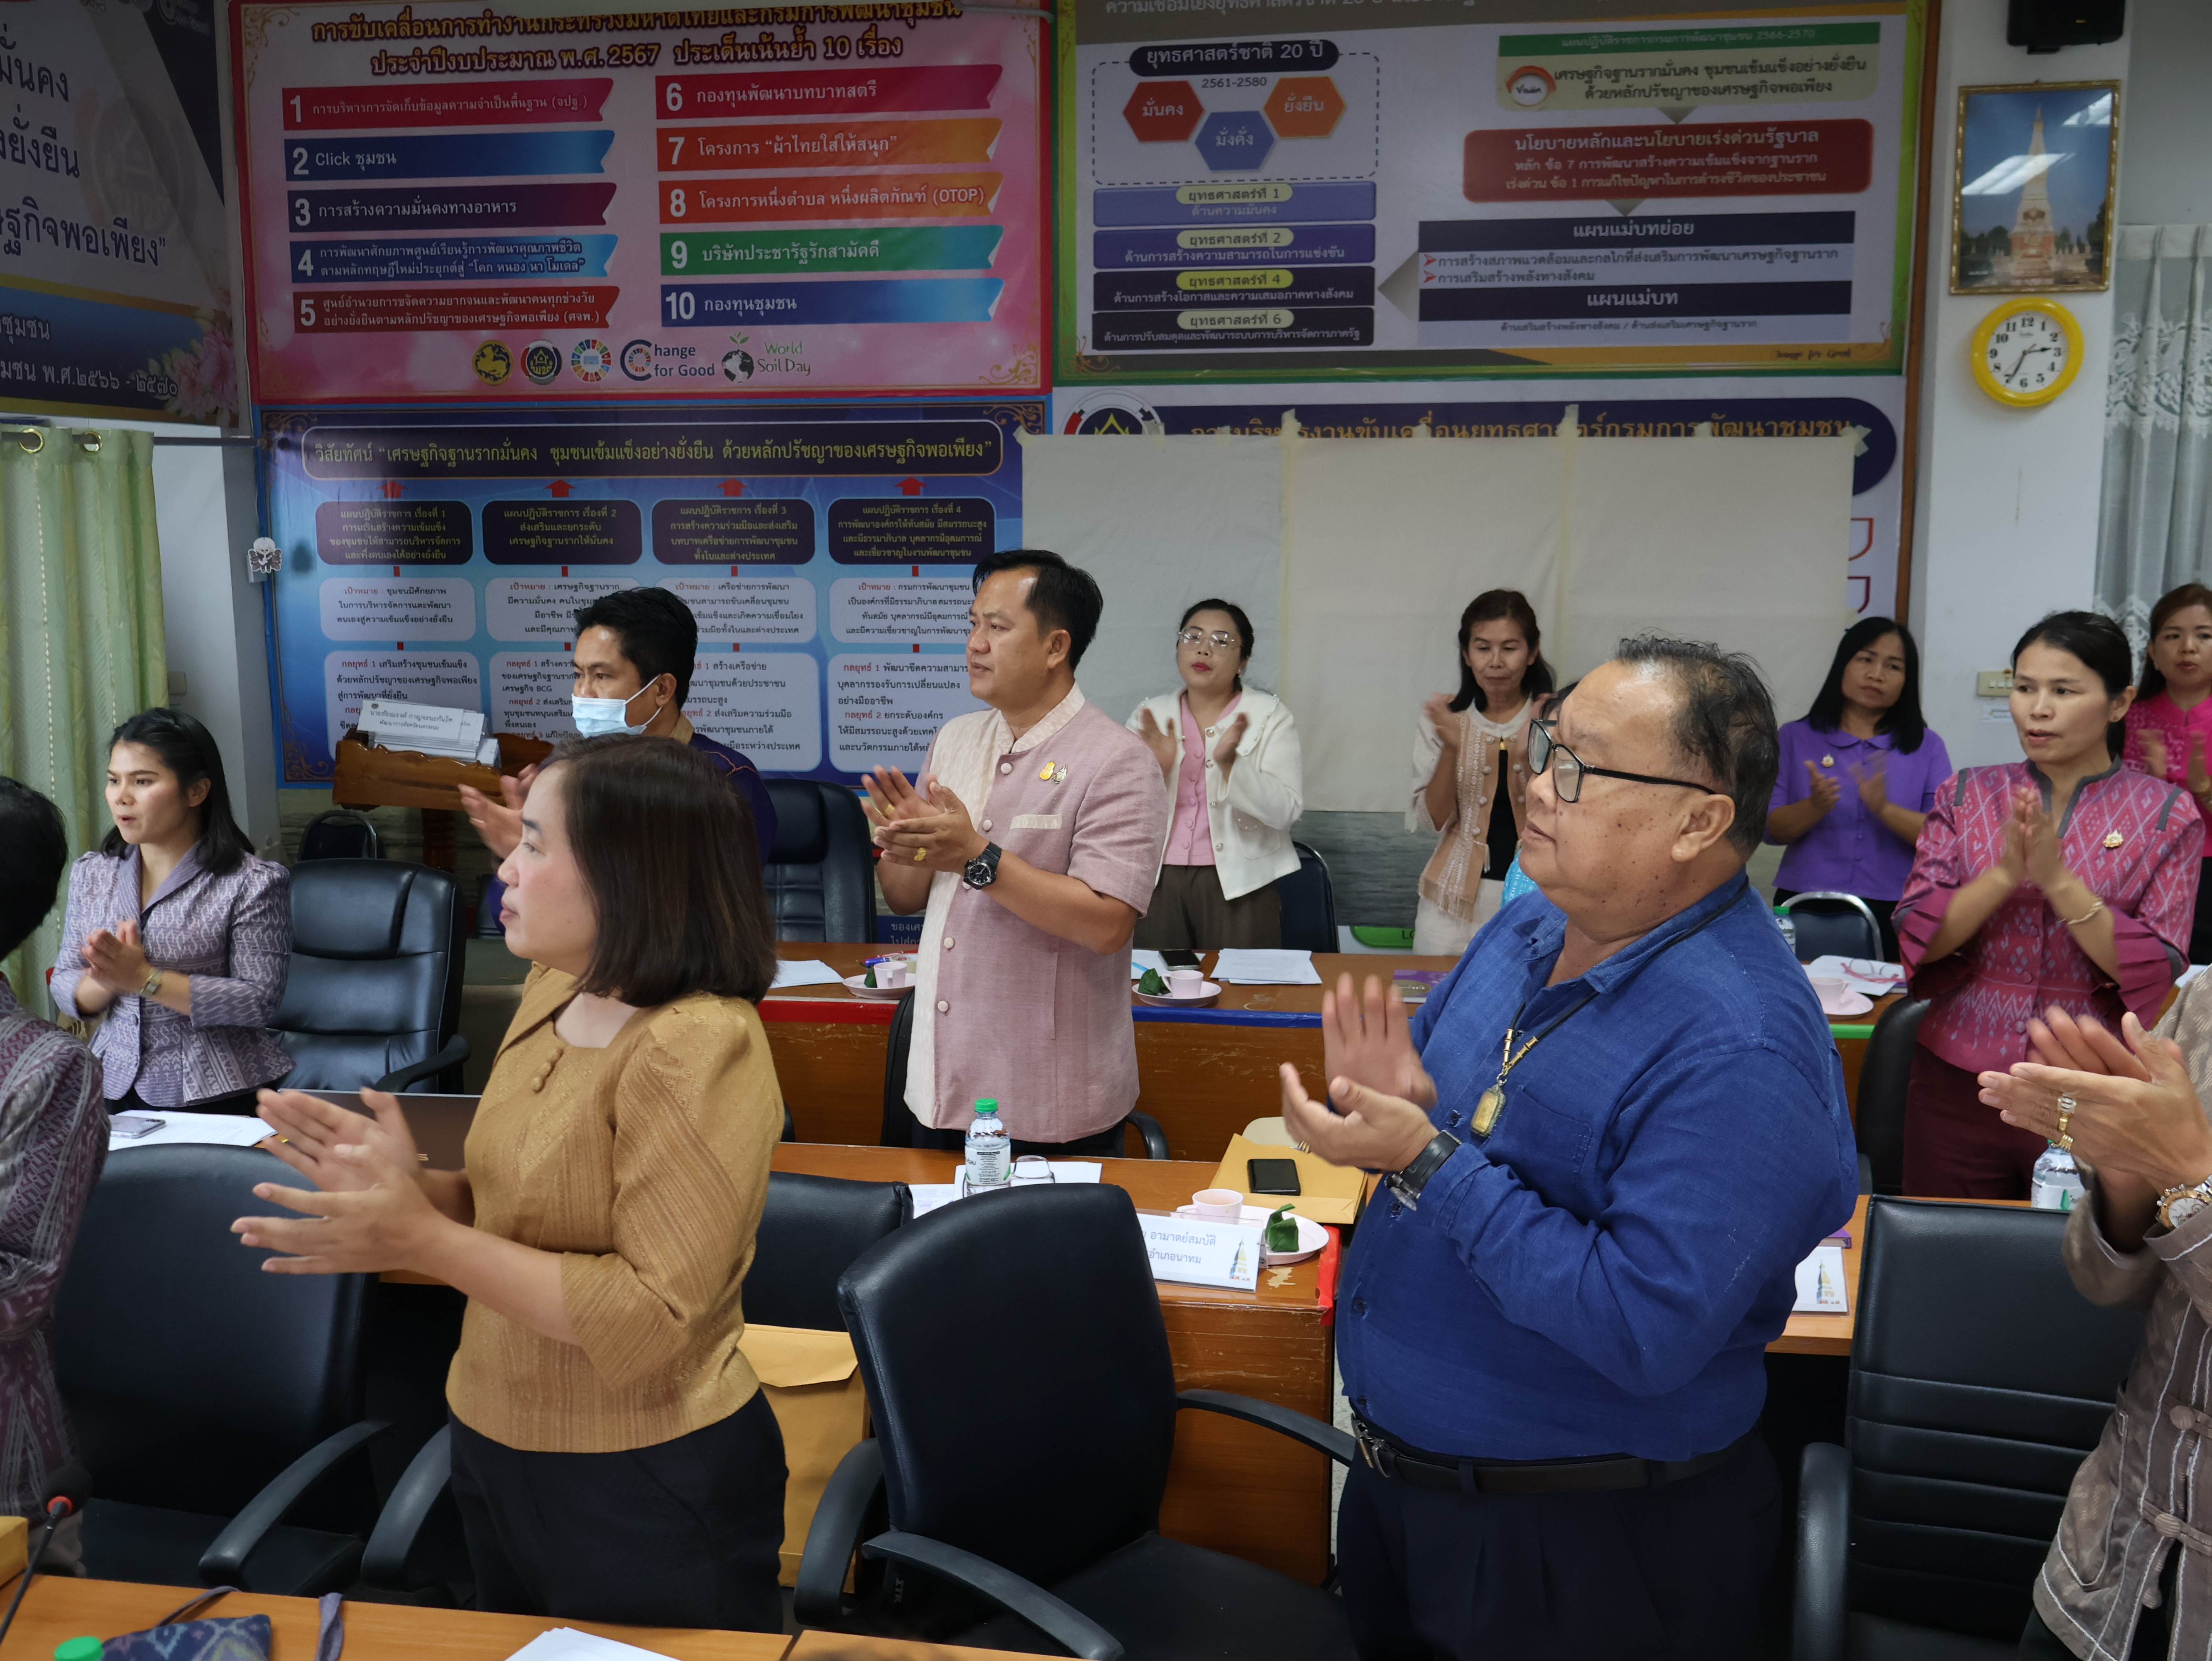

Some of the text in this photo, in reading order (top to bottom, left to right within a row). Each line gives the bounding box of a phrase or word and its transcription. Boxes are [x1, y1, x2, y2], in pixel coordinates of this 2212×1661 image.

[372, 45, 555, 75] ประจำปีงบประมาณ
[673, 27, 816, 65] ประเด็นเน้นย้ำ
[825, 35, 851, 60] 10
[857, 24, 904, 58] เรื่อง
[1147, 39, 1324, 69] ยุทธศาสตร์ชาติ 20 ปี
[1555, 59, 1698, 84] เศรษฐกิจฐานรากมั่นคง
[1201, 76, 1267, 89] 2561-2580
[1585, 77, 1832, 100] ด้วยหลักปรัชญาของเศรษฐกิจพอเพียง
[666, 80, 878, 112] 6 กองทุนพัฒนาบทบาทสตรี
[1284, 93, 1324, 113] ยั่งยืน
[289, 91, 587, 122] 1 การบริหารการจัดเก็บข้อมูลความจำเป็นพื้นฐาน (จปฐ.)
[1142, 97, 1184, 118] มั่นคง
[1215, 126, 1254, 147] มั่งคั่ง
[1515, 129, 1819, 152] นโยบายหลักและนโยบายเร่งด่วนรัฐบาล
[668, 133, 898, 164] 7 โครงการ “ผ้าไทยใส่ให้สนุก”
[293, 147, 397, 175] 2 Click ชุมชน
[1567, 159, 1574, 169] 7
[1571, 177, 1577, 188] 1
[669, 182, 985, 218] 8 โครงการหนึ่งตำบล หนึ่งผลิตภัณฑ์ (OTOP)
[1189, 188, 1279, 203] ยุทธศาสตร์ที่ 1
[295, 194, 517, 227] 3 การสร้างความมั่นคงทางอาหาร
[0, 195, 166, 266] ฐกิจพอเพียง”
[1573, 219, 1695, 239] แผนแม่บทย่อย
[1189, 231, 1281, 247] ยุทธศาสตร์ที่ 2
[297, 239, 582, 277] 4 การพัฒนาศักยภาพศูนย์เรียนรู้การพัฒนาคุณภาพชีวิต
[671, 239, 880, 269] 9 บริษัทประชารัฐรักสามัคคี
[321, 262, 465, 279] ตามหลักทฤษฎีใหม่ประยุกต์สู่
[498, 262, 526, 273] หนอง
[530, 262, 545, 272] นา
[548, 257, 585, 273] โมเดล”
[1189, 274, 1280, 289] ยุทธศาสตร์ที่ 4
[1587, 287, 1679, 307] แผนแม่บท
[299, 293, 595, 327] 5 ศูนย์อำนวยการขจัดความยากจนและพัฒนาคนทุกช่วงวัย
[665, 291, 798, 320] 10 กองทุนชุมชน
[324, 310, 600, 328] อย่างยั่งยืนตามหลักปรัชญาของเศรษฐกิจพอเพียง (ศจพ.)
[1190, 314, 1281, 329] ยุทธศาสตร์ที่ 6
[2006, 321, 2017, 332] 11
[2021, 317, 2034, 328] 12
[0, 314, 50, 345] ชุมชน
[2049, 332, 2058, 342] 2
[1995, 333, 2009, 344] 10
[764, 341, 803, 355] World
[1989, 348, 1998, 359] 9
[2053, 347, 2062, 357] 3
[654, 364, 715, 377] for Good
[757, 358, 811, 377] Soil Day
[2047, 362, 2055, 372] 4
[2019, 378, 2028, 388] 6
[2036, 373, 2045, 383] 5
[314, 436, 992, 468] วิสัยทัศน์ “เศรษฐกิจฐานรากมั่นคง ชุมชนเข้มแข็งอย่างยั่งยืน ด้วยหลักปรัชญาของเศรษฐกิจพอเพียง”
[441, 510, 445, 518] 1
[504, 505, 617, 520] แผนปฏิบัติราชการ เรื่องที่ 2
[680, 503, 787, 517] แผนปฏิบัติราชการ เรื่องที่ 3
[932, 503, 953, 515] เรื่องที่
[955, 506, 962, 514] 4
[344, 586, 378, 595] เป้าหมาย
[858, 583, 891, 591] เป้าหมาย
[342, 659, 368, 670] กลยุทธ์
[507, 659, 531, 669] กลยุทธ์
[843, 662, 872, 674] กลยุทธ์
[509, 697, 533, 707] กลยุทธ์
[838, 696, 893, 705] อย่างมืออาชีพ
[845, 710, 873, 721] กลยุทธ์
[885, 710, 944, 720] ยกระดับองค์กร
[1150, 1231, 1216, 1246] อามาตย์สมบัติ
[1147, 1248, 1201, 1264] อำเภอนาทม
